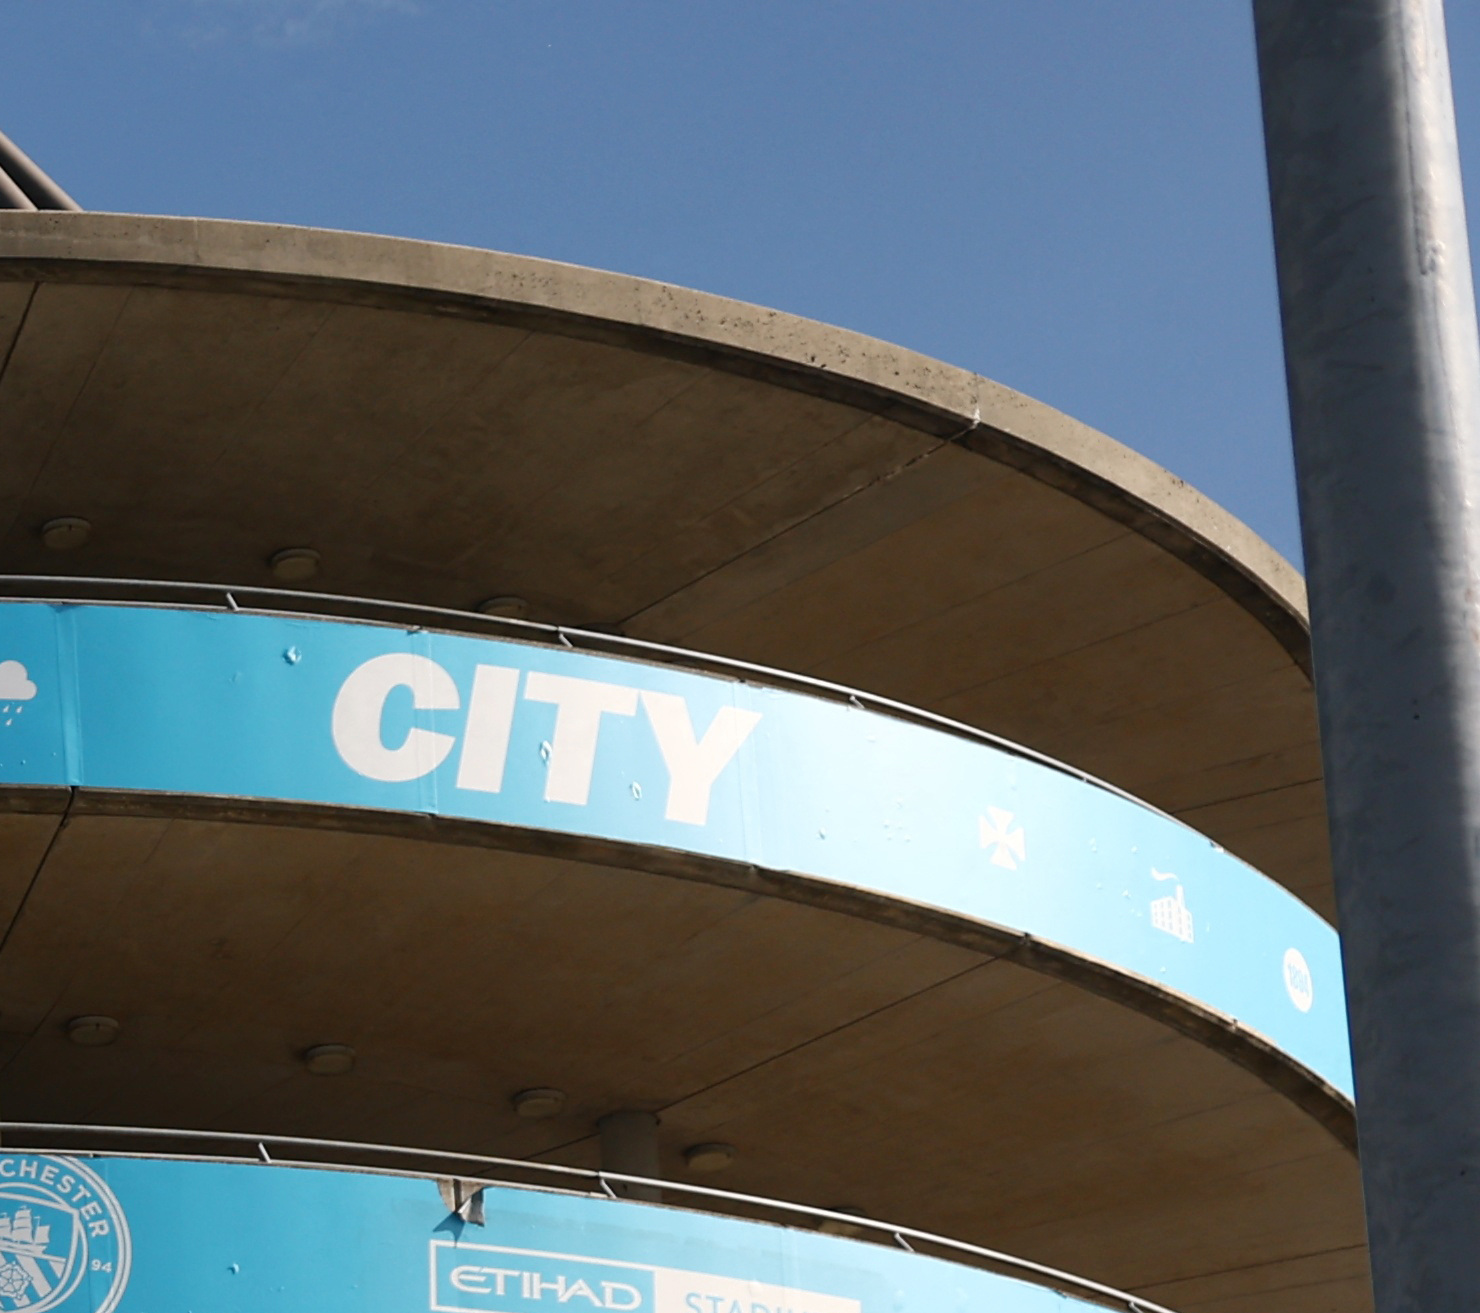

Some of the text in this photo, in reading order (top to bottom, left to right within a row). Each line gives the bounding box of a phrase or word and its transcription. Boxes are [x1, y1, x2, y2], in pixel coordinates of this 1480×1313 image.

[331, 652, 763, 827] CITY
[91, 1259, 113, 1274] 94
[449, 1264, 642, 1312] ETIHAD
